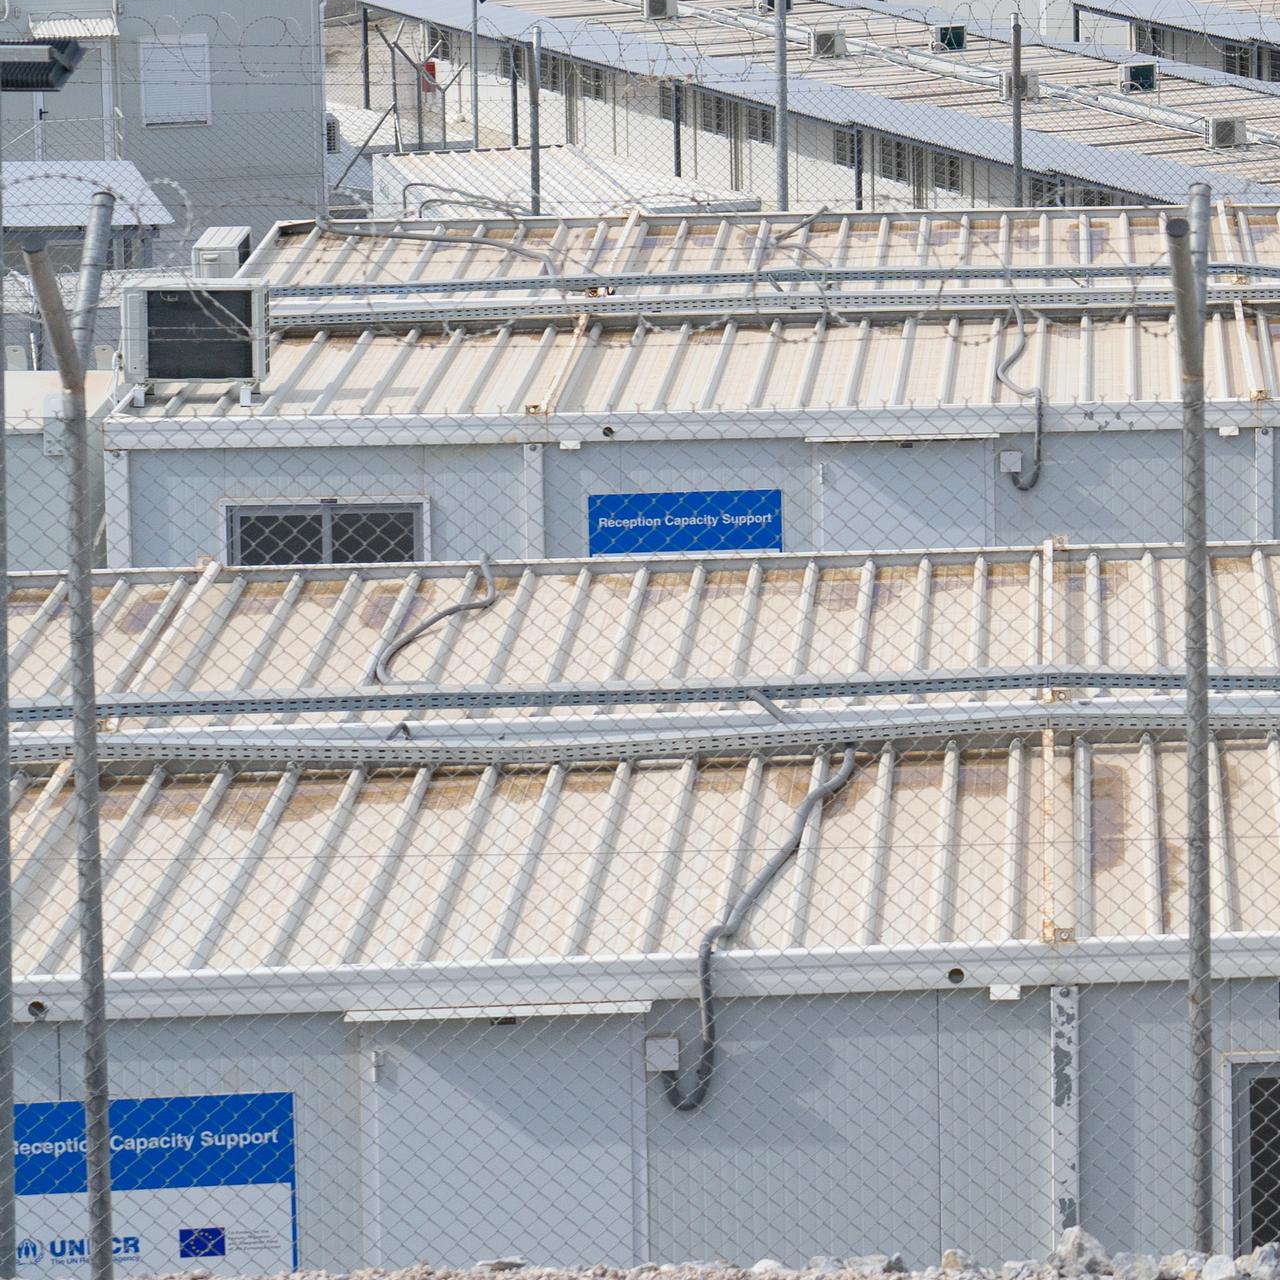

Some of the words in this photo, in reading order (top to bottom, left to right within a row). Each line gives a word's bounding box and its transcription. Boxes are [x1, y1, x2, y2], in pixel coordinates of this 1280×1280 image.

[599, 517, 662, 529] Reception
[664, 514, 719, 527] Capacity
[722, 513, 772, 525] Support
[14, 1137, 88, 1158] eceptio
[109, 1132, 195, 1154] Capacity
[200, 1128, 279, 1150] Support
